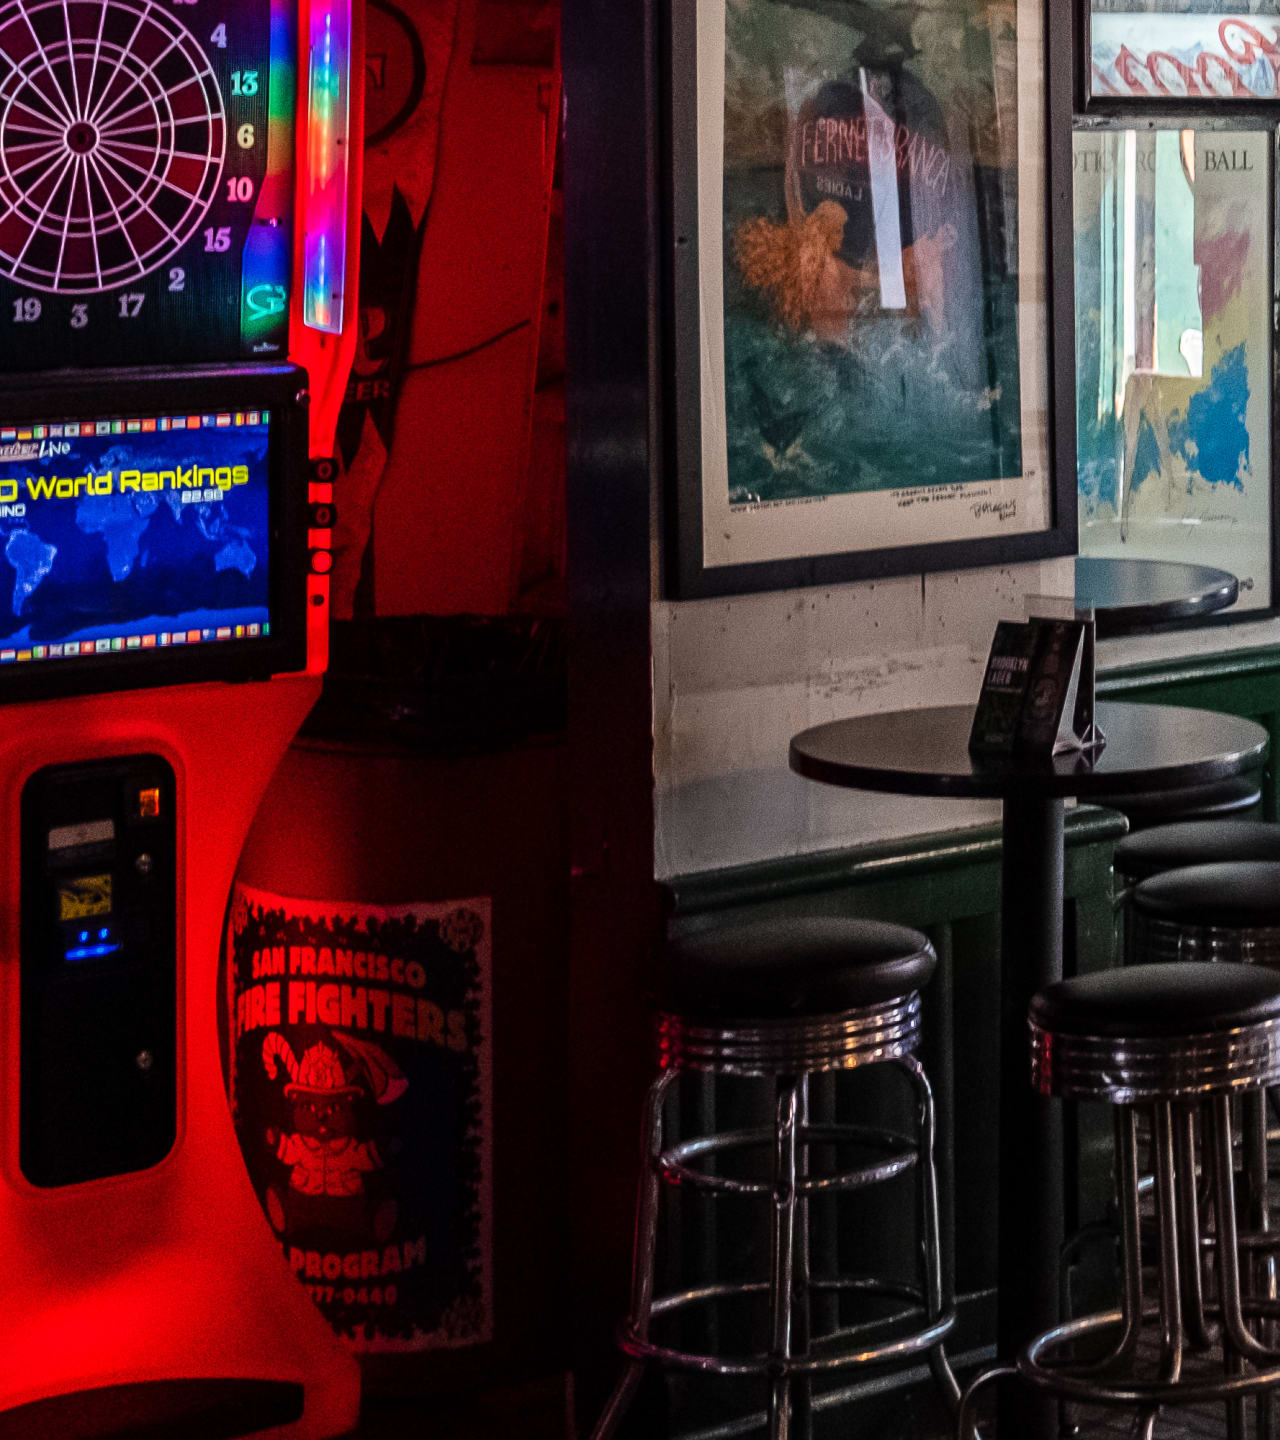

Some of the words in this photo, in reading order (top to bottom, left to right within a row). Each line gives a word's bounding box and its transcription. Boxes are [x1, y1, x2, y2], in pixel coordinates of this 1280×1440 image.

[210, 23, 228, 48] 4
[230, 70, 259, 96] 13
[236, 122, 256, 149] 6
[800, 116, 872, 168] FERNE
[1205, 149, 1254, 172] BALL
[227, 176, 254, 202] 10
[203, 227, 232, 253] 15
[168, 267, 186, 292] 2
[12, 297, 42, 324] 19
[70, 304, 89, 329] 3
[118, 293, 146, 318] 17
[26, 469, 114, 502] World
[120, 464, 249, 494] Rankings
[252, 946, 285, 980] SAN
[288, 945, 428, 990] FRANCISCO
[236, 981, 281, 1038] FIRE
[287, 980, 468, 1053] FIGHTERS
[288, 1235, 428, 1280] PROGRAM
